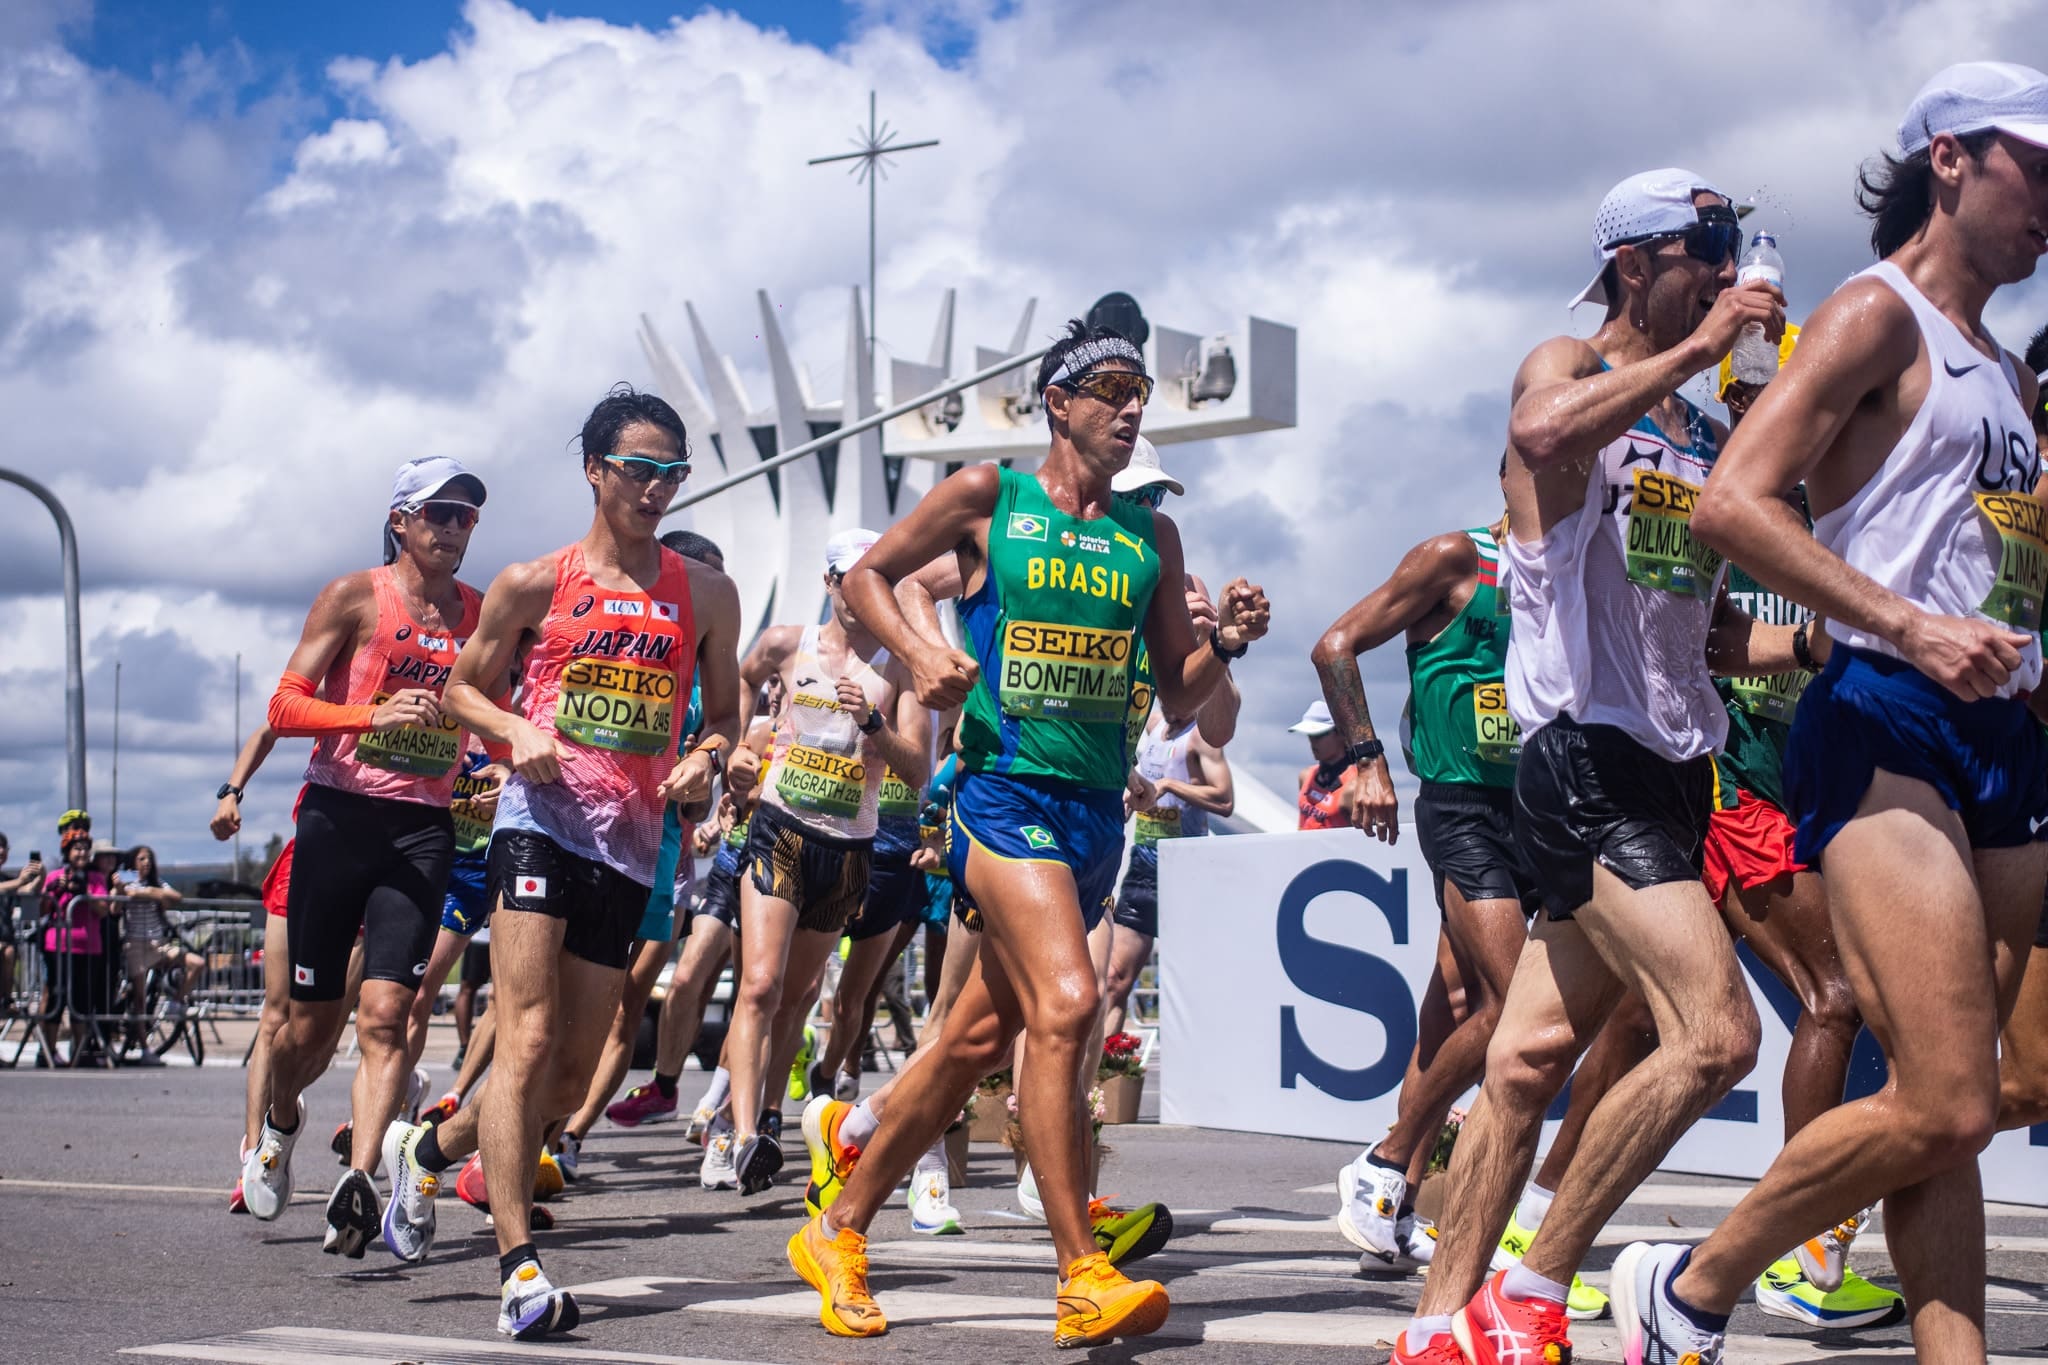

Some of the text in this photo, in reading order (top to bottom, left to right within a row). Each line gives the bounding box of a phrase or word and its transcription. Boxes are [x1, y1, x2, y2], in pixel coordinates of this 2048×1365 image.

[1639, 475, 1700, 513] SEI
[1983, 496, 2048, 546] SEIK
[1079, 541, 1110, 554] CAIXA
[1027, 557, 1133, 608] BRASIL
[572, 629, 675, 661] JAPAN
[1010, 626, 1128, 661] SEIKO
[389, 655, 451, 687] JAPA
[566, 662, 674, 699] SEIKO
[1007, 660, 1105, 697] BONFIM
[1108, 674, 1126, 698] 205
[563, 691, 670, 733] NODA 245
[1043, 698, 1069, 708] CAIXA
[594, 727, 619, 738] CAIXA
[1482, 716, 1522, 741] CHA
[441, 741, 457, 759] 246
[788, 748, 865, 781] SEIKO
[781, 767, 862, 804] McGRATH 228
[879, 783, 903, 800] NATO
